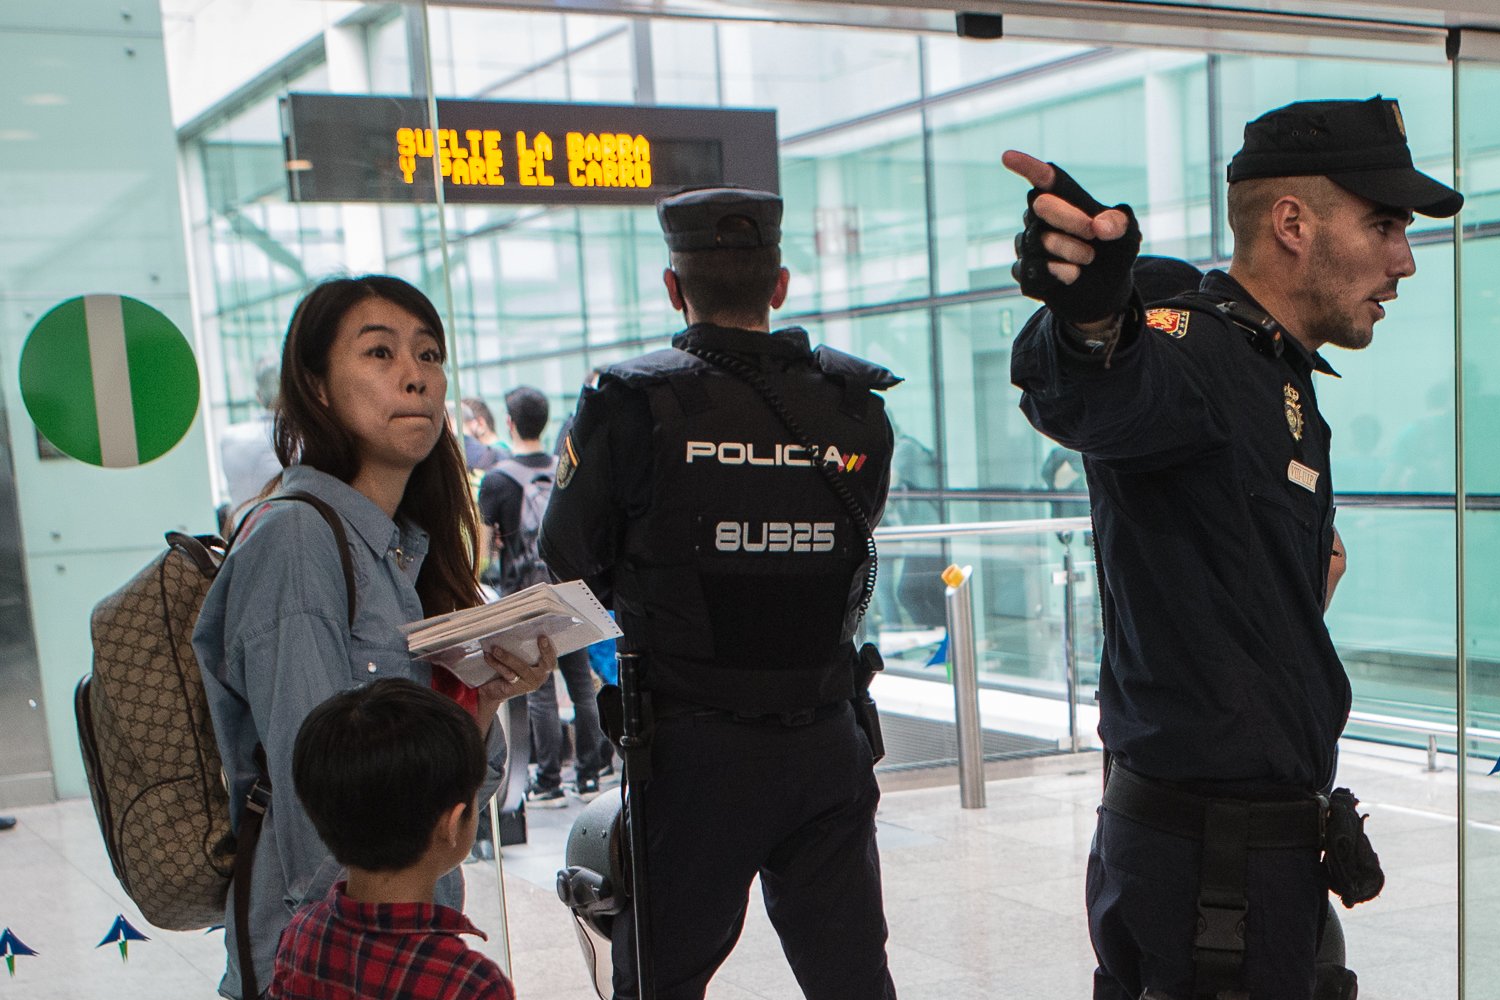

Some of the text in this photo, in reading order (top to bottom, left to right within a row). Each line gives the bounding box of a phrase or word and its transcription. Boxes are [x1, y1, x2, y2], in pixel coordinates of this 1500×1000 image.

[396, 127, 651, 162] SUELTE LA BARRA
[398, 156, 652, 188] Y PARE EL CARRO
[715, 521, 835, 552] 8U325
